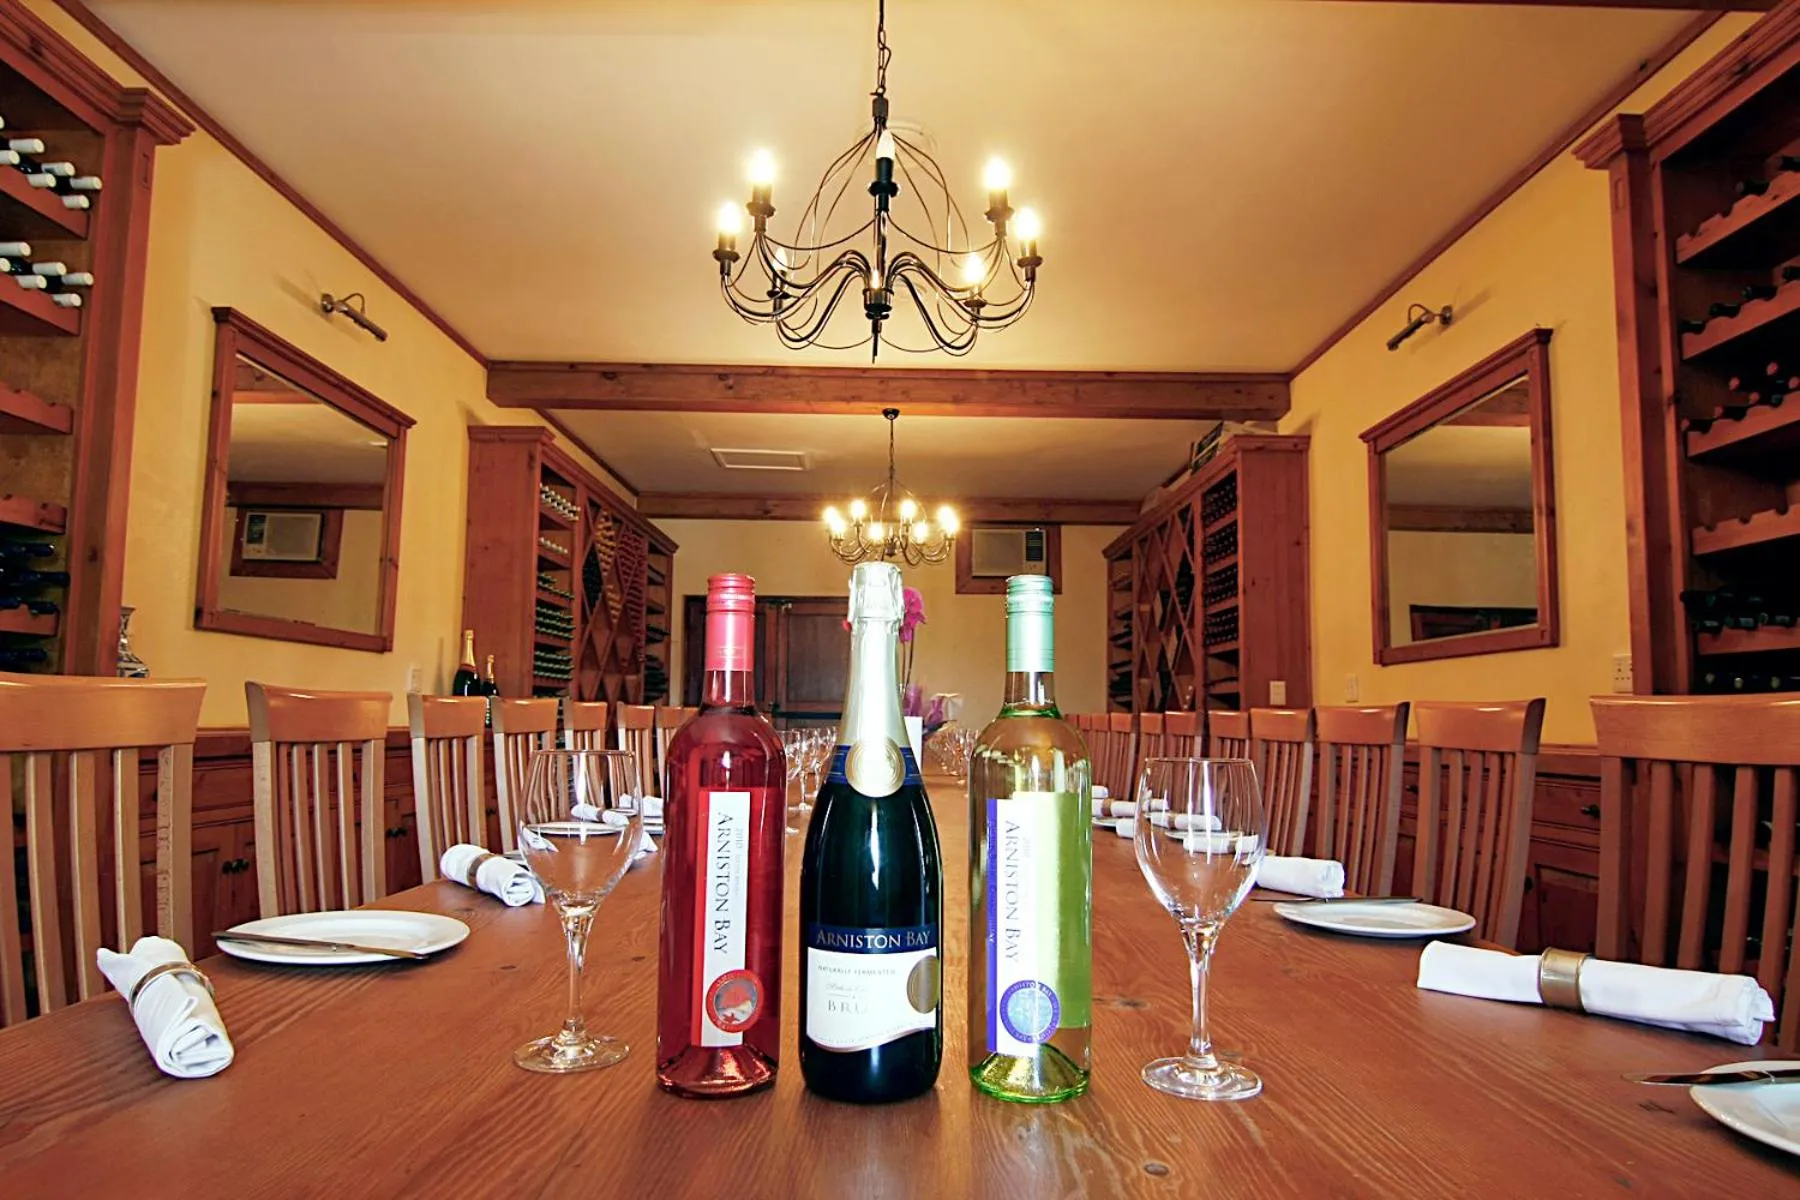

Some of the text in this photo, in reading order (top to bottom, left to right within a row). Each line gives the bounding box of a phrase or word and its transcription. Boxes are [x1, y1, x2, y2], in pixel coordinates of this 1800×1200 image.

[714, 811, 734, 955] ARNISTON BAY
[1005, 820, 1022, 963] ARNISTON BAY
[816, 929, 931, 949] ARNISTON BAY
[828, 999, 868, 1015] BRU
